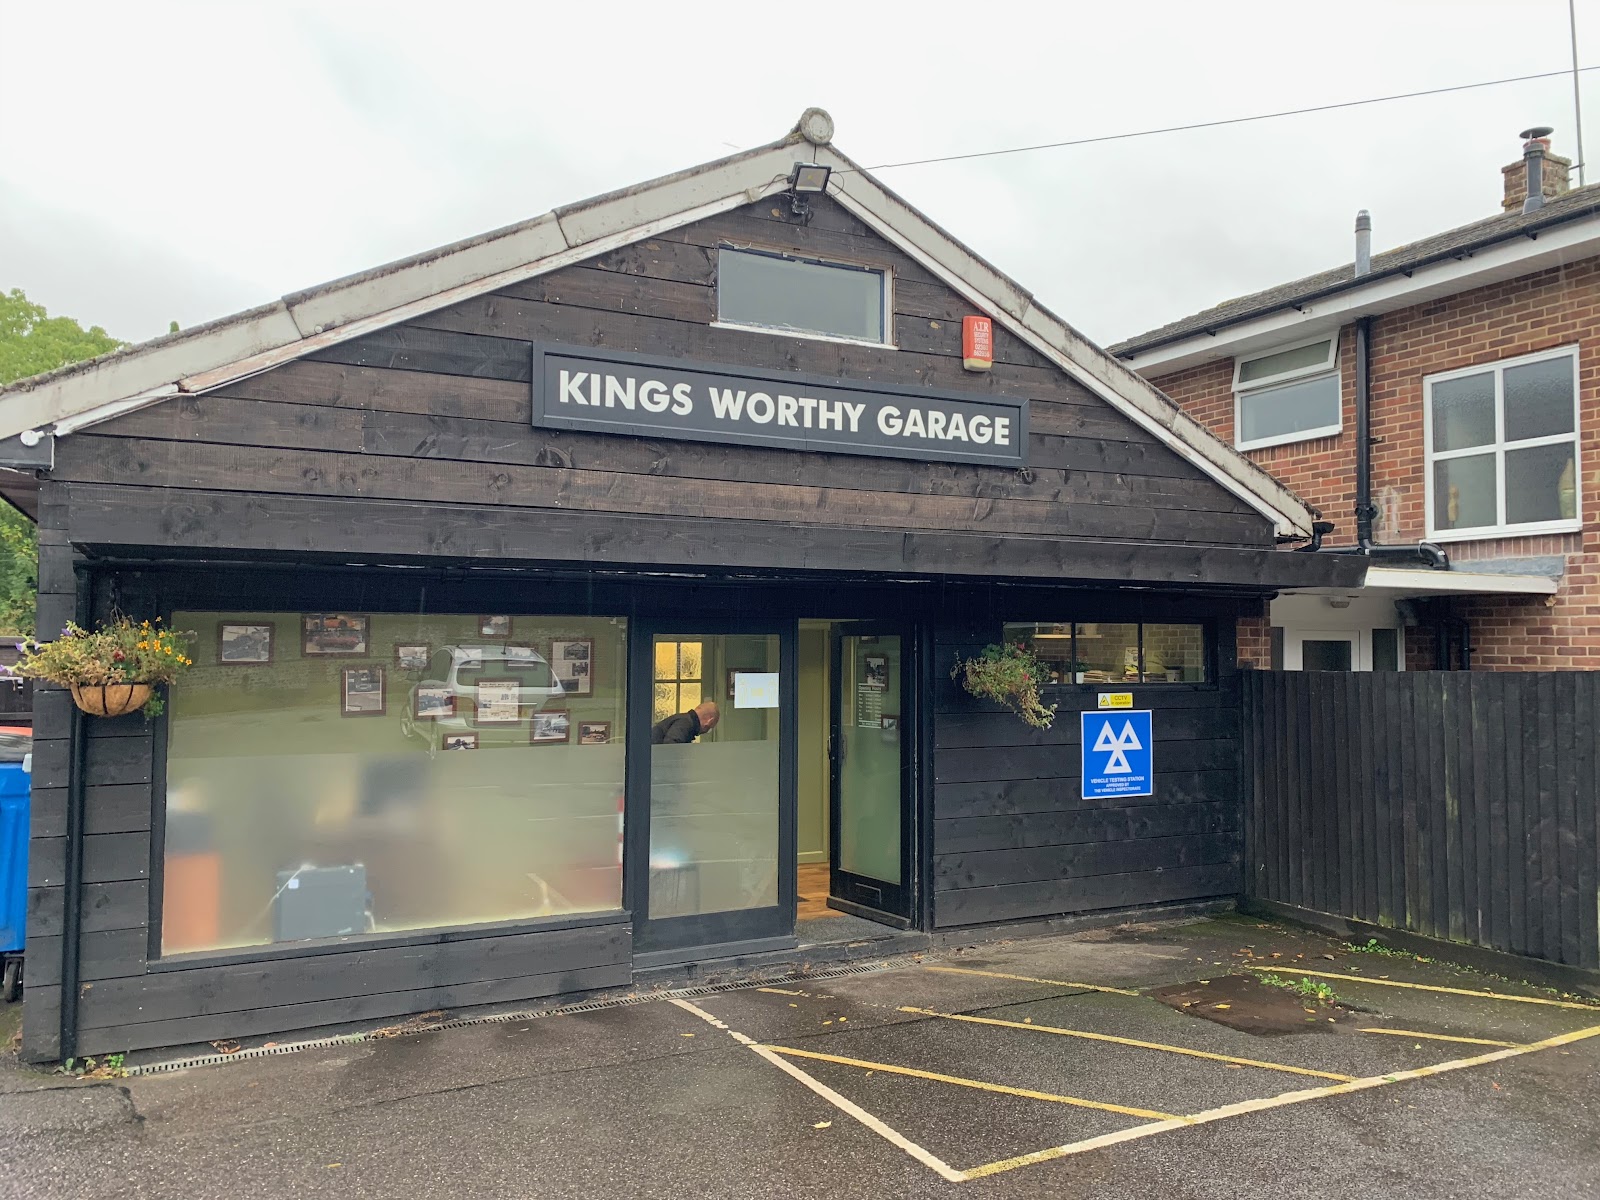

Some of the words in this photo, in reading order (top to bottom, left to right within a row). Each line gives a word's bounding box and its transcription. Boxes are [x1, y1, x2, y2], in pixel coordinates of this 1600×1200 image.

[559, 369, 693, 416] KINGS
[708, 386, 867, 432] WORTHY
[877, 405, 1010, 446] GARAGE
